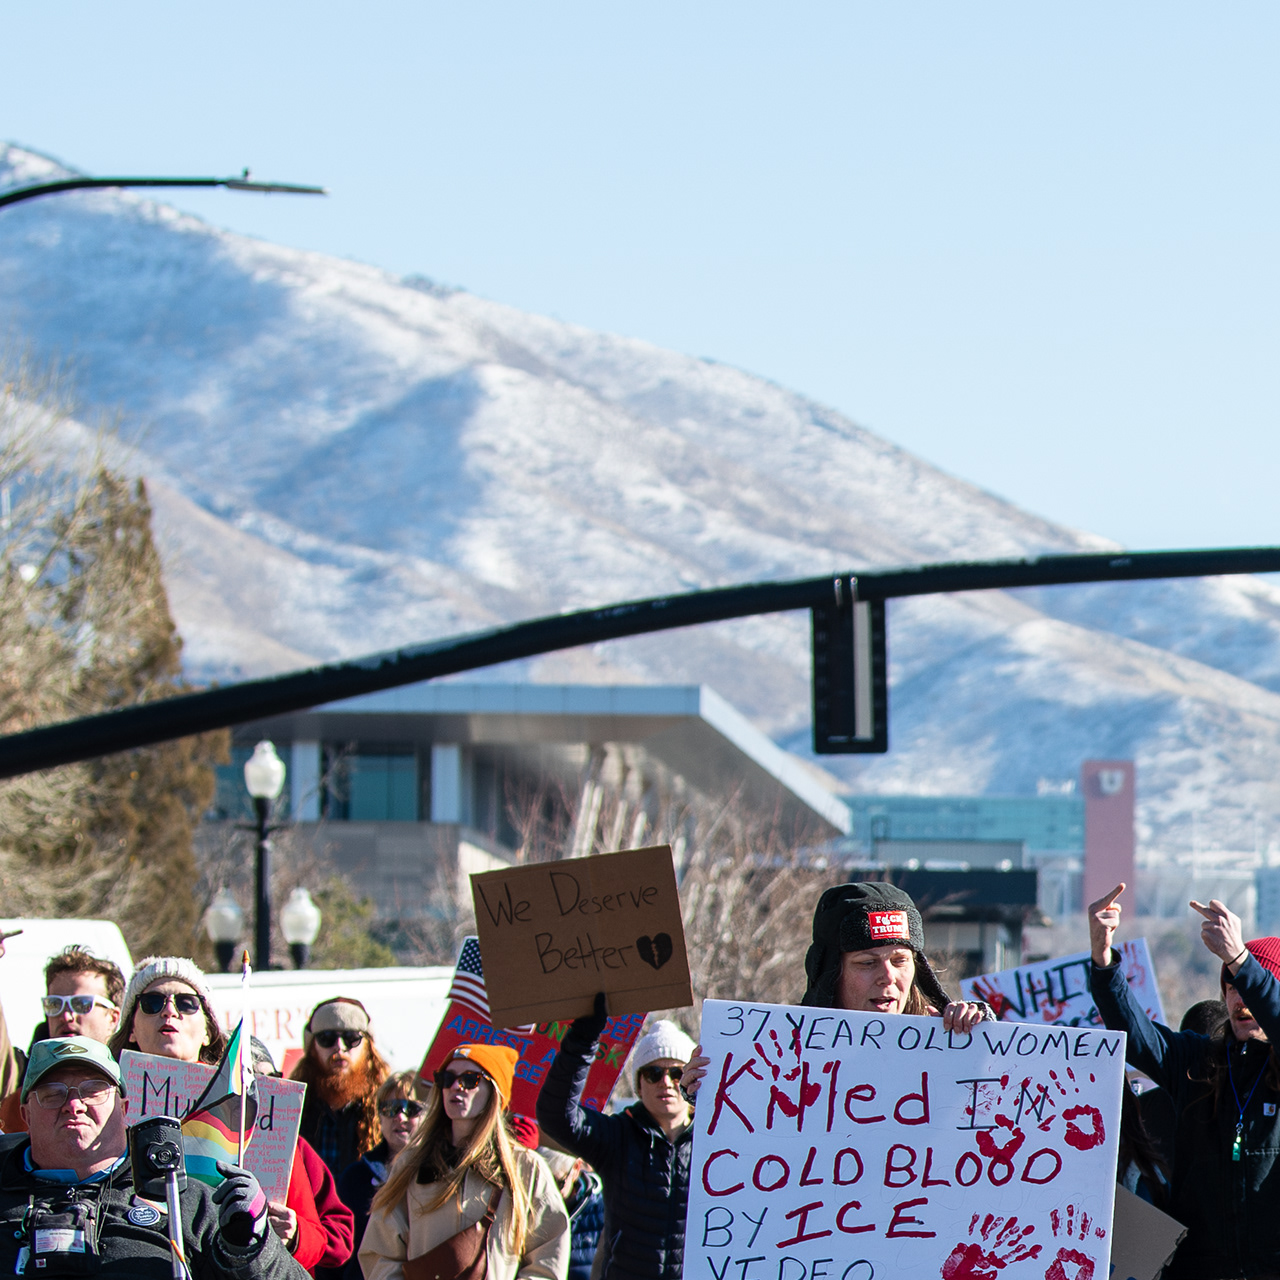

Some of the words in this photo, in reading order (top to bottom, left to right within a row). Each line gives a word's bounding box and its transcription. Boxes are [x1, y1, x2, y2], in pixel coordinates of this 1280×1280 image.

[477, 882, 532, 927] We
[550, 870, 658, 917] Deserve
[534, 931, 634, 975] Better
[446, 1014, 534, 1057] ARREST
[719, 1006, 772, 1043] 37
[786, 1013, 886, 1052] YEAR
[897, 1025, 973, 1052] OLD
[983, 1029, 1122, 1061] WOMEN
[701, 1145, 865, 1197] COLD
[883, 1142, 1063, 1189] BLOOD
[701, 1205, 769, 1249] BY
[776, 1197, 937, 1249] ICE
